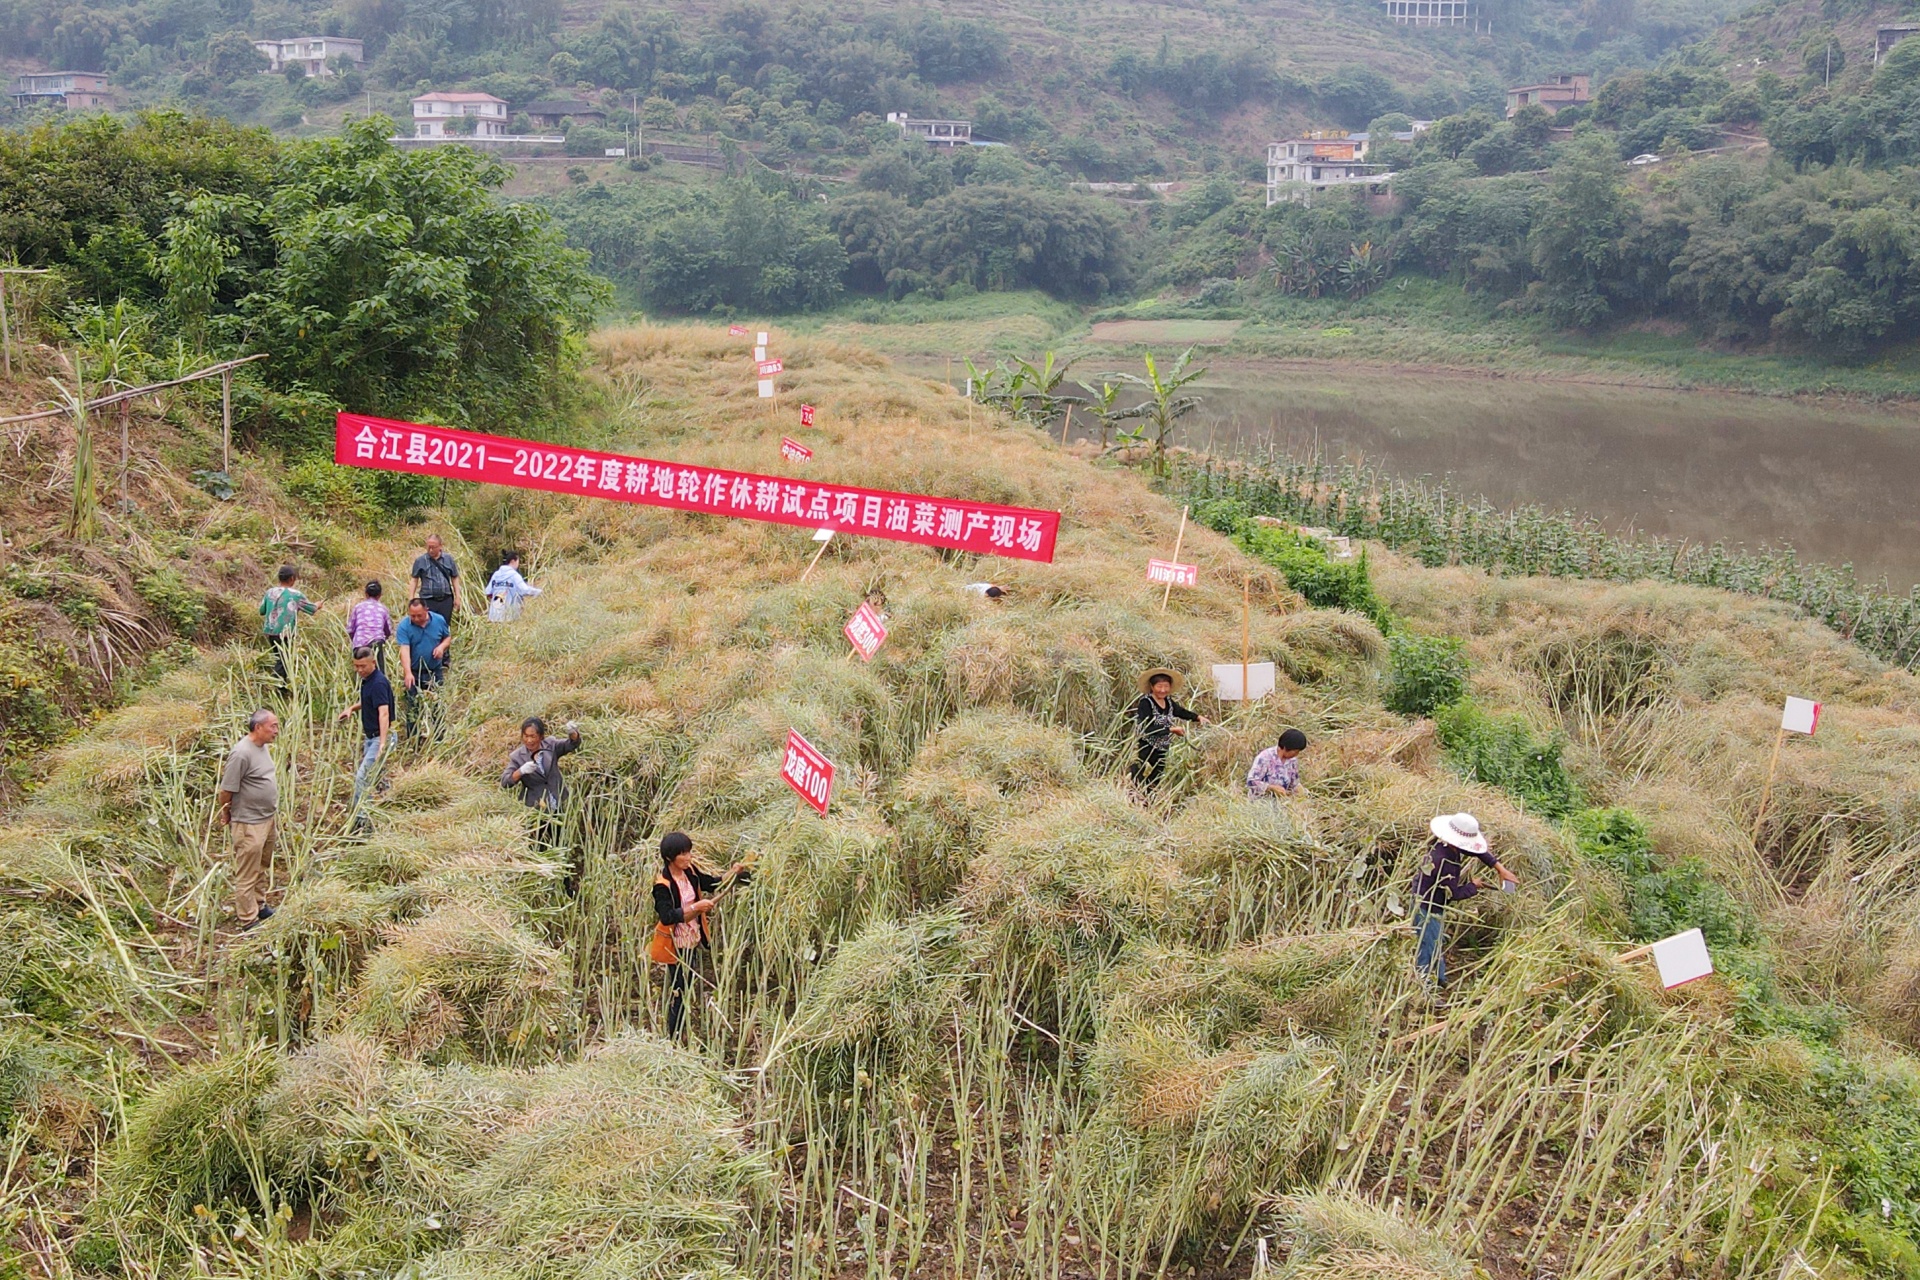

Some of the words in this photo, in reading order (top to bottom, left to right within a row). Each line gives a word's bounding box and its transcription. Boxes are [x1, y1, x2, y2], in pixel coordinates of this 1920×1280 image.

[354, 425, 1043, 552] 合江县2021—2022年度耕地轮作休耕试点项目油菜测产现场
[784, 746, 828, 804] 龙庭100
